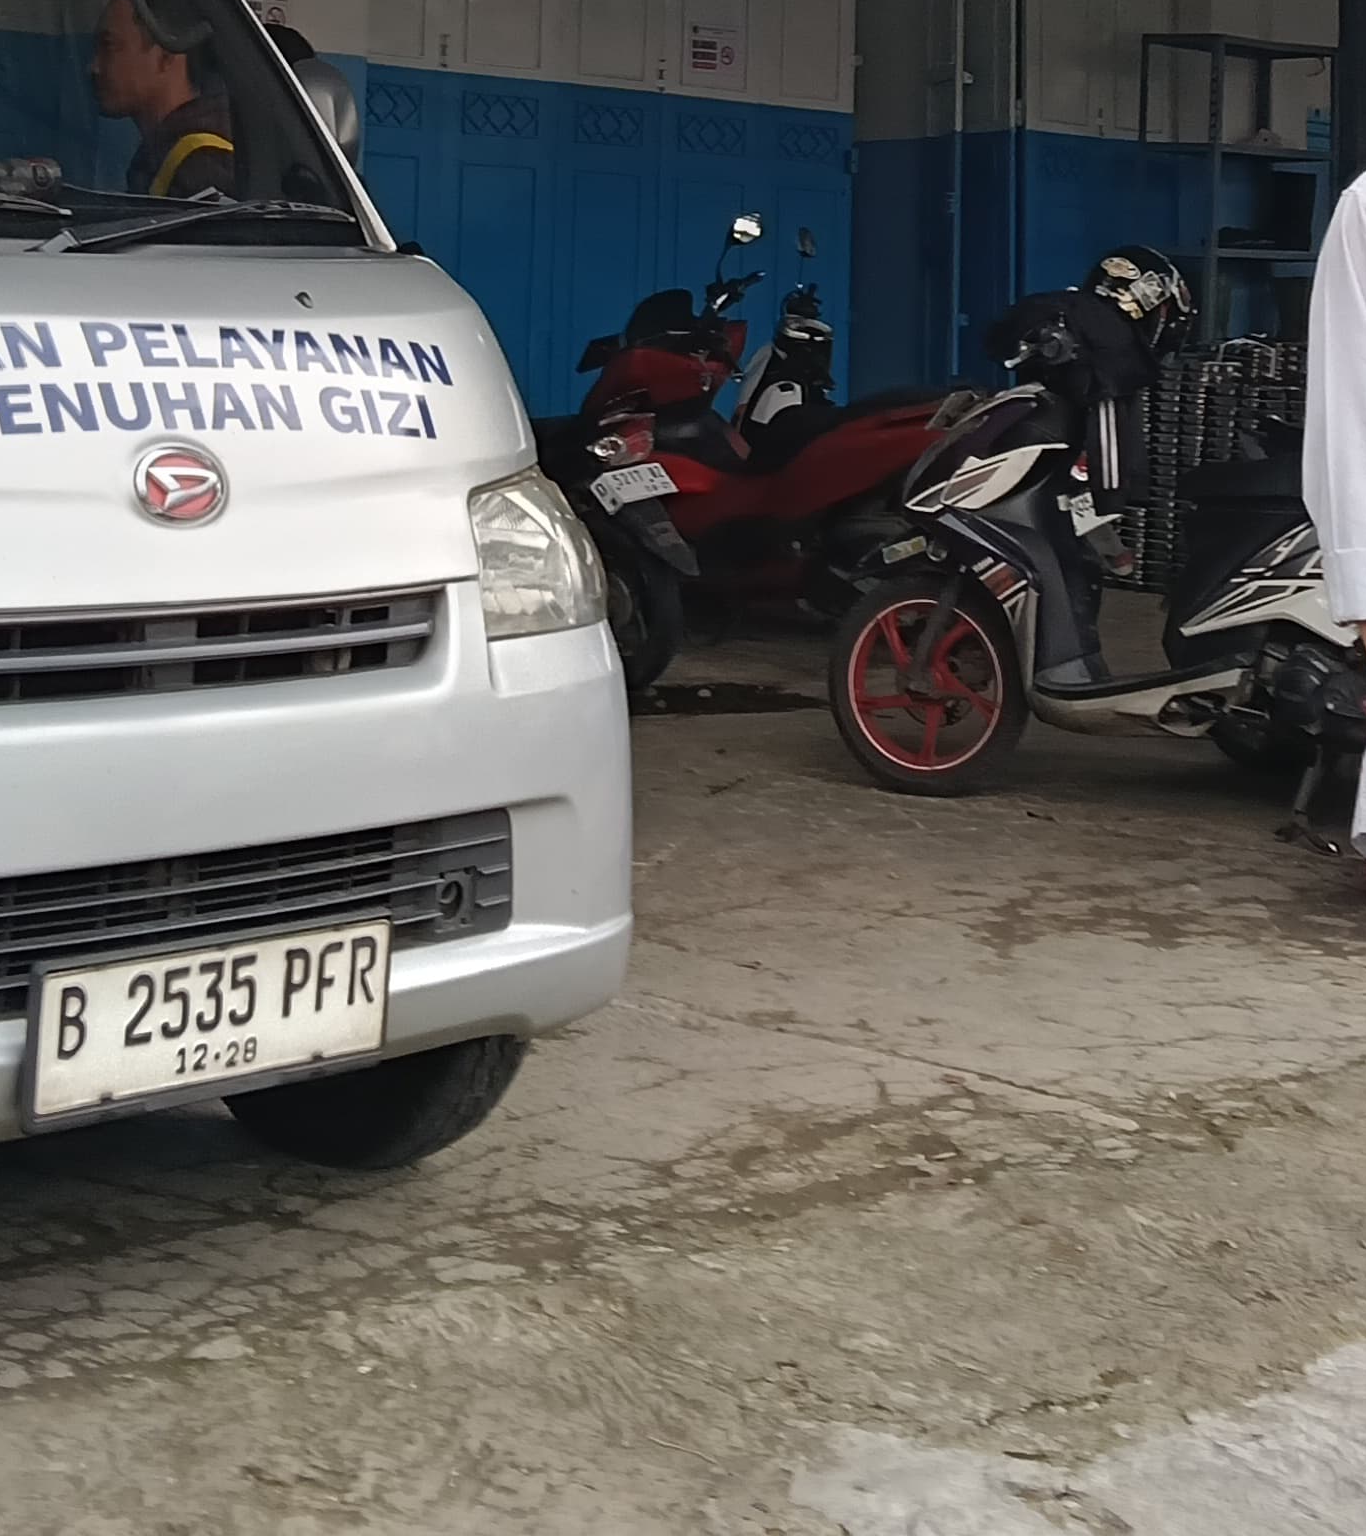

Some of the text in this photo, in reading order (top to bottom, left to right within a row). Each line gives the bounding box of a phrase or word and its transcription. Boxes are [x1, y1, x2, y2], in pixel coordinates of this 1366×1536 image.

[79, 321, 453, 387] PELAYANAN
[317, 385, 437, 439] GIZI
[57, 935, 378, 1060] B 2535 PFR
